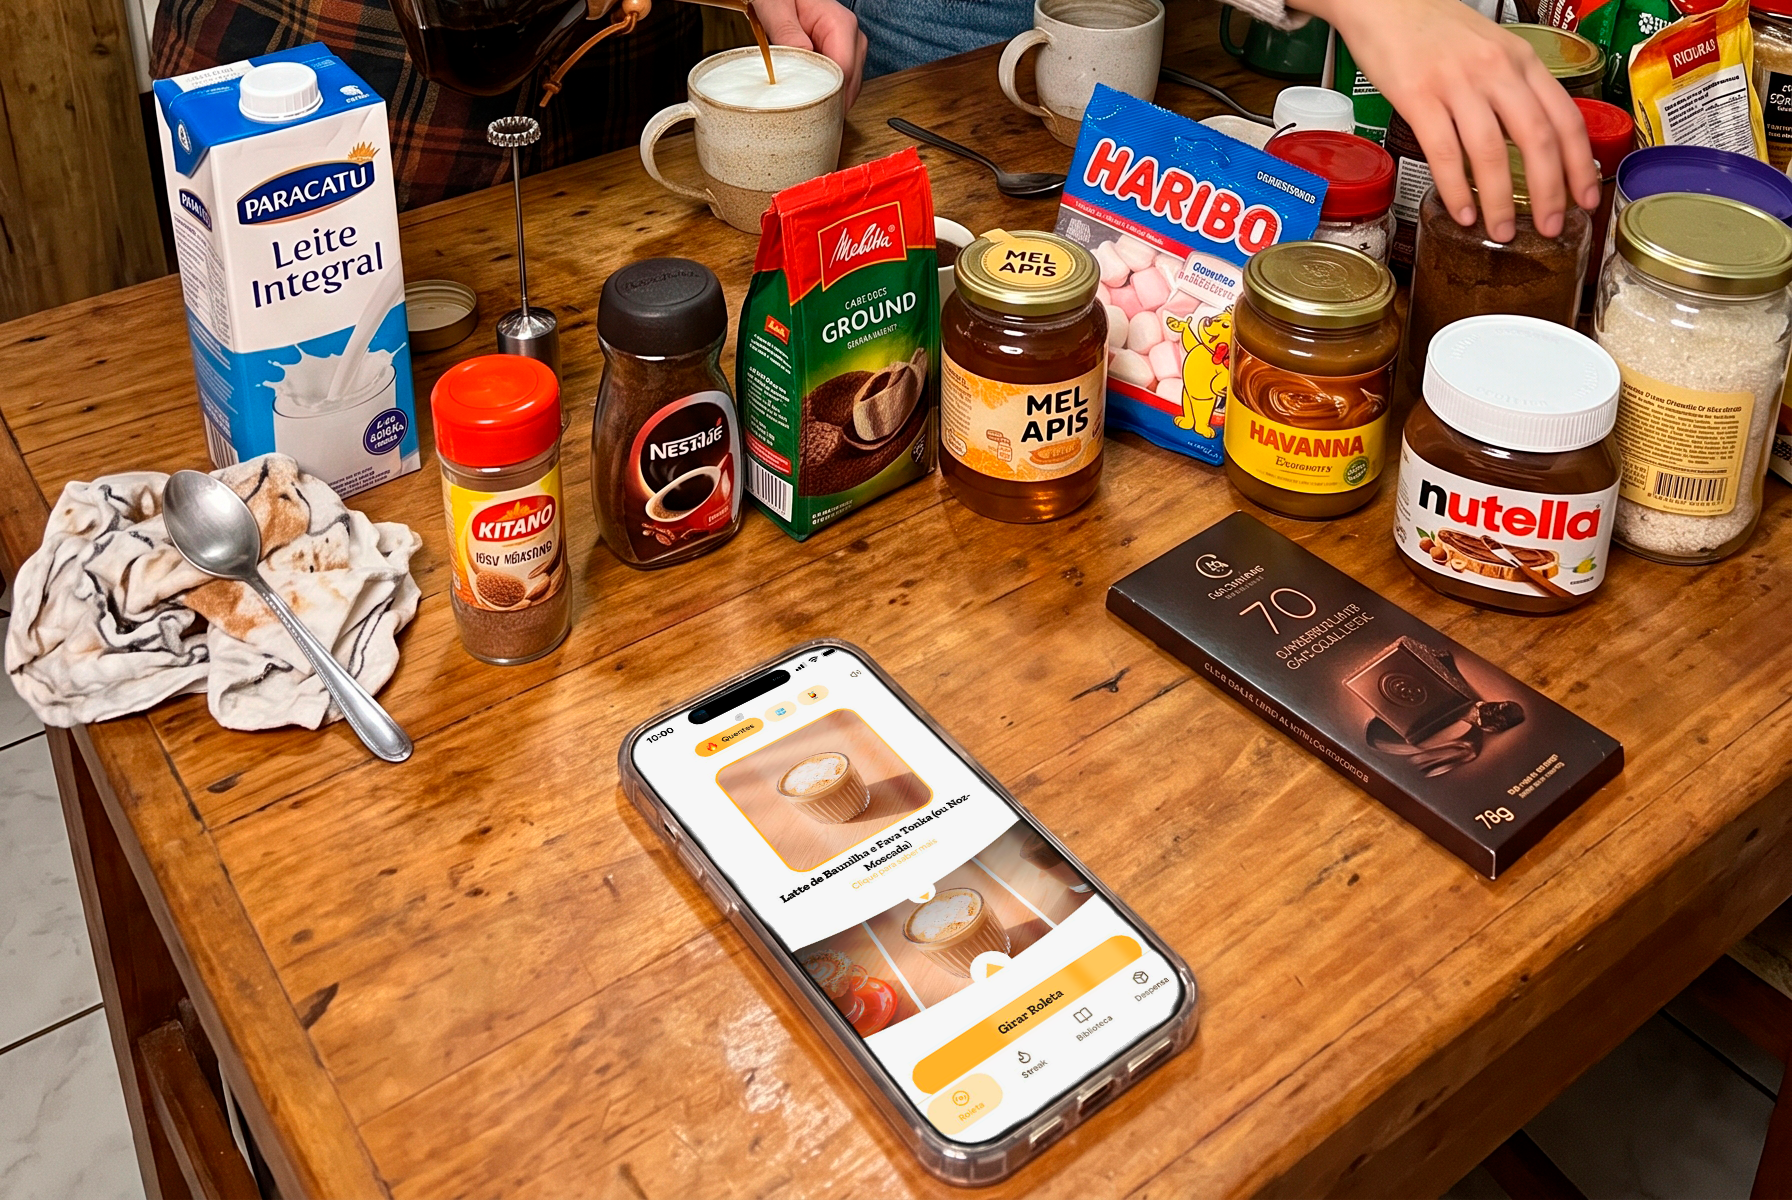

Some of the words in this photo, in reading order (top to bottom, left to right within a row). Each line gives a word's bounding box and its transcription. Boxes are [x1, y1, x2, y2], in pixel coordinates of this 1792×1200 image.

[245, 167, 367, 220] PARACATU
[1084, 139, 1281, 256] HARIBO
[272, 226, 358, 269] Leite
[1005, 250, 1057, 265] MEL
[252, 242, 383, 308] Integral
[999, 262, 1056, 277] APIS
[822, 292, 916, 343] GROUND
[1027, 385, 1089, 416] MEL
[1021, 408, 1088, 442] APIS
[1250, 419, 1364, 458] HAVANNA
[478, 504, 553, 539] KITANO
[1419, 479, 1600, 541] nutella
[1239, 587, 1317, 635] 70
[646, 727, 674, 743] 10:00
[721, 724, 755, 742] Quentes
[1475, 807, 1515, 829] 78g
[779, 882, 811, 903] Latte
[810, 875, 824, 888] de
[822, 850, 870, 879] Baunilha
[870, 845, 877, 853] e
[875, 832, 902, 848] Fava
[899, 814, 933, 836] Tonka
[931, 806, 948, 819] (ou
[946, 794, 971, 810] Noz-
[851, 872, 879, 890] Clique
[878, 863, 897, 877] para
[897, 849, 919, 865] saber
[919, 838, 938, 851] mais
[863, 841, 913, 871] Moscada)
[1135, 976, 1170, 1002] Despensa
[997, 1012, 1029, 1035] Girar
[1027, 989, 1064, 1016] Roleta
[1076, 1014, 1113, 1042] Biblioteca
[1021, 1059, 1049, 1079] Streak
[958, 1102, 985, 1122] Roleta
